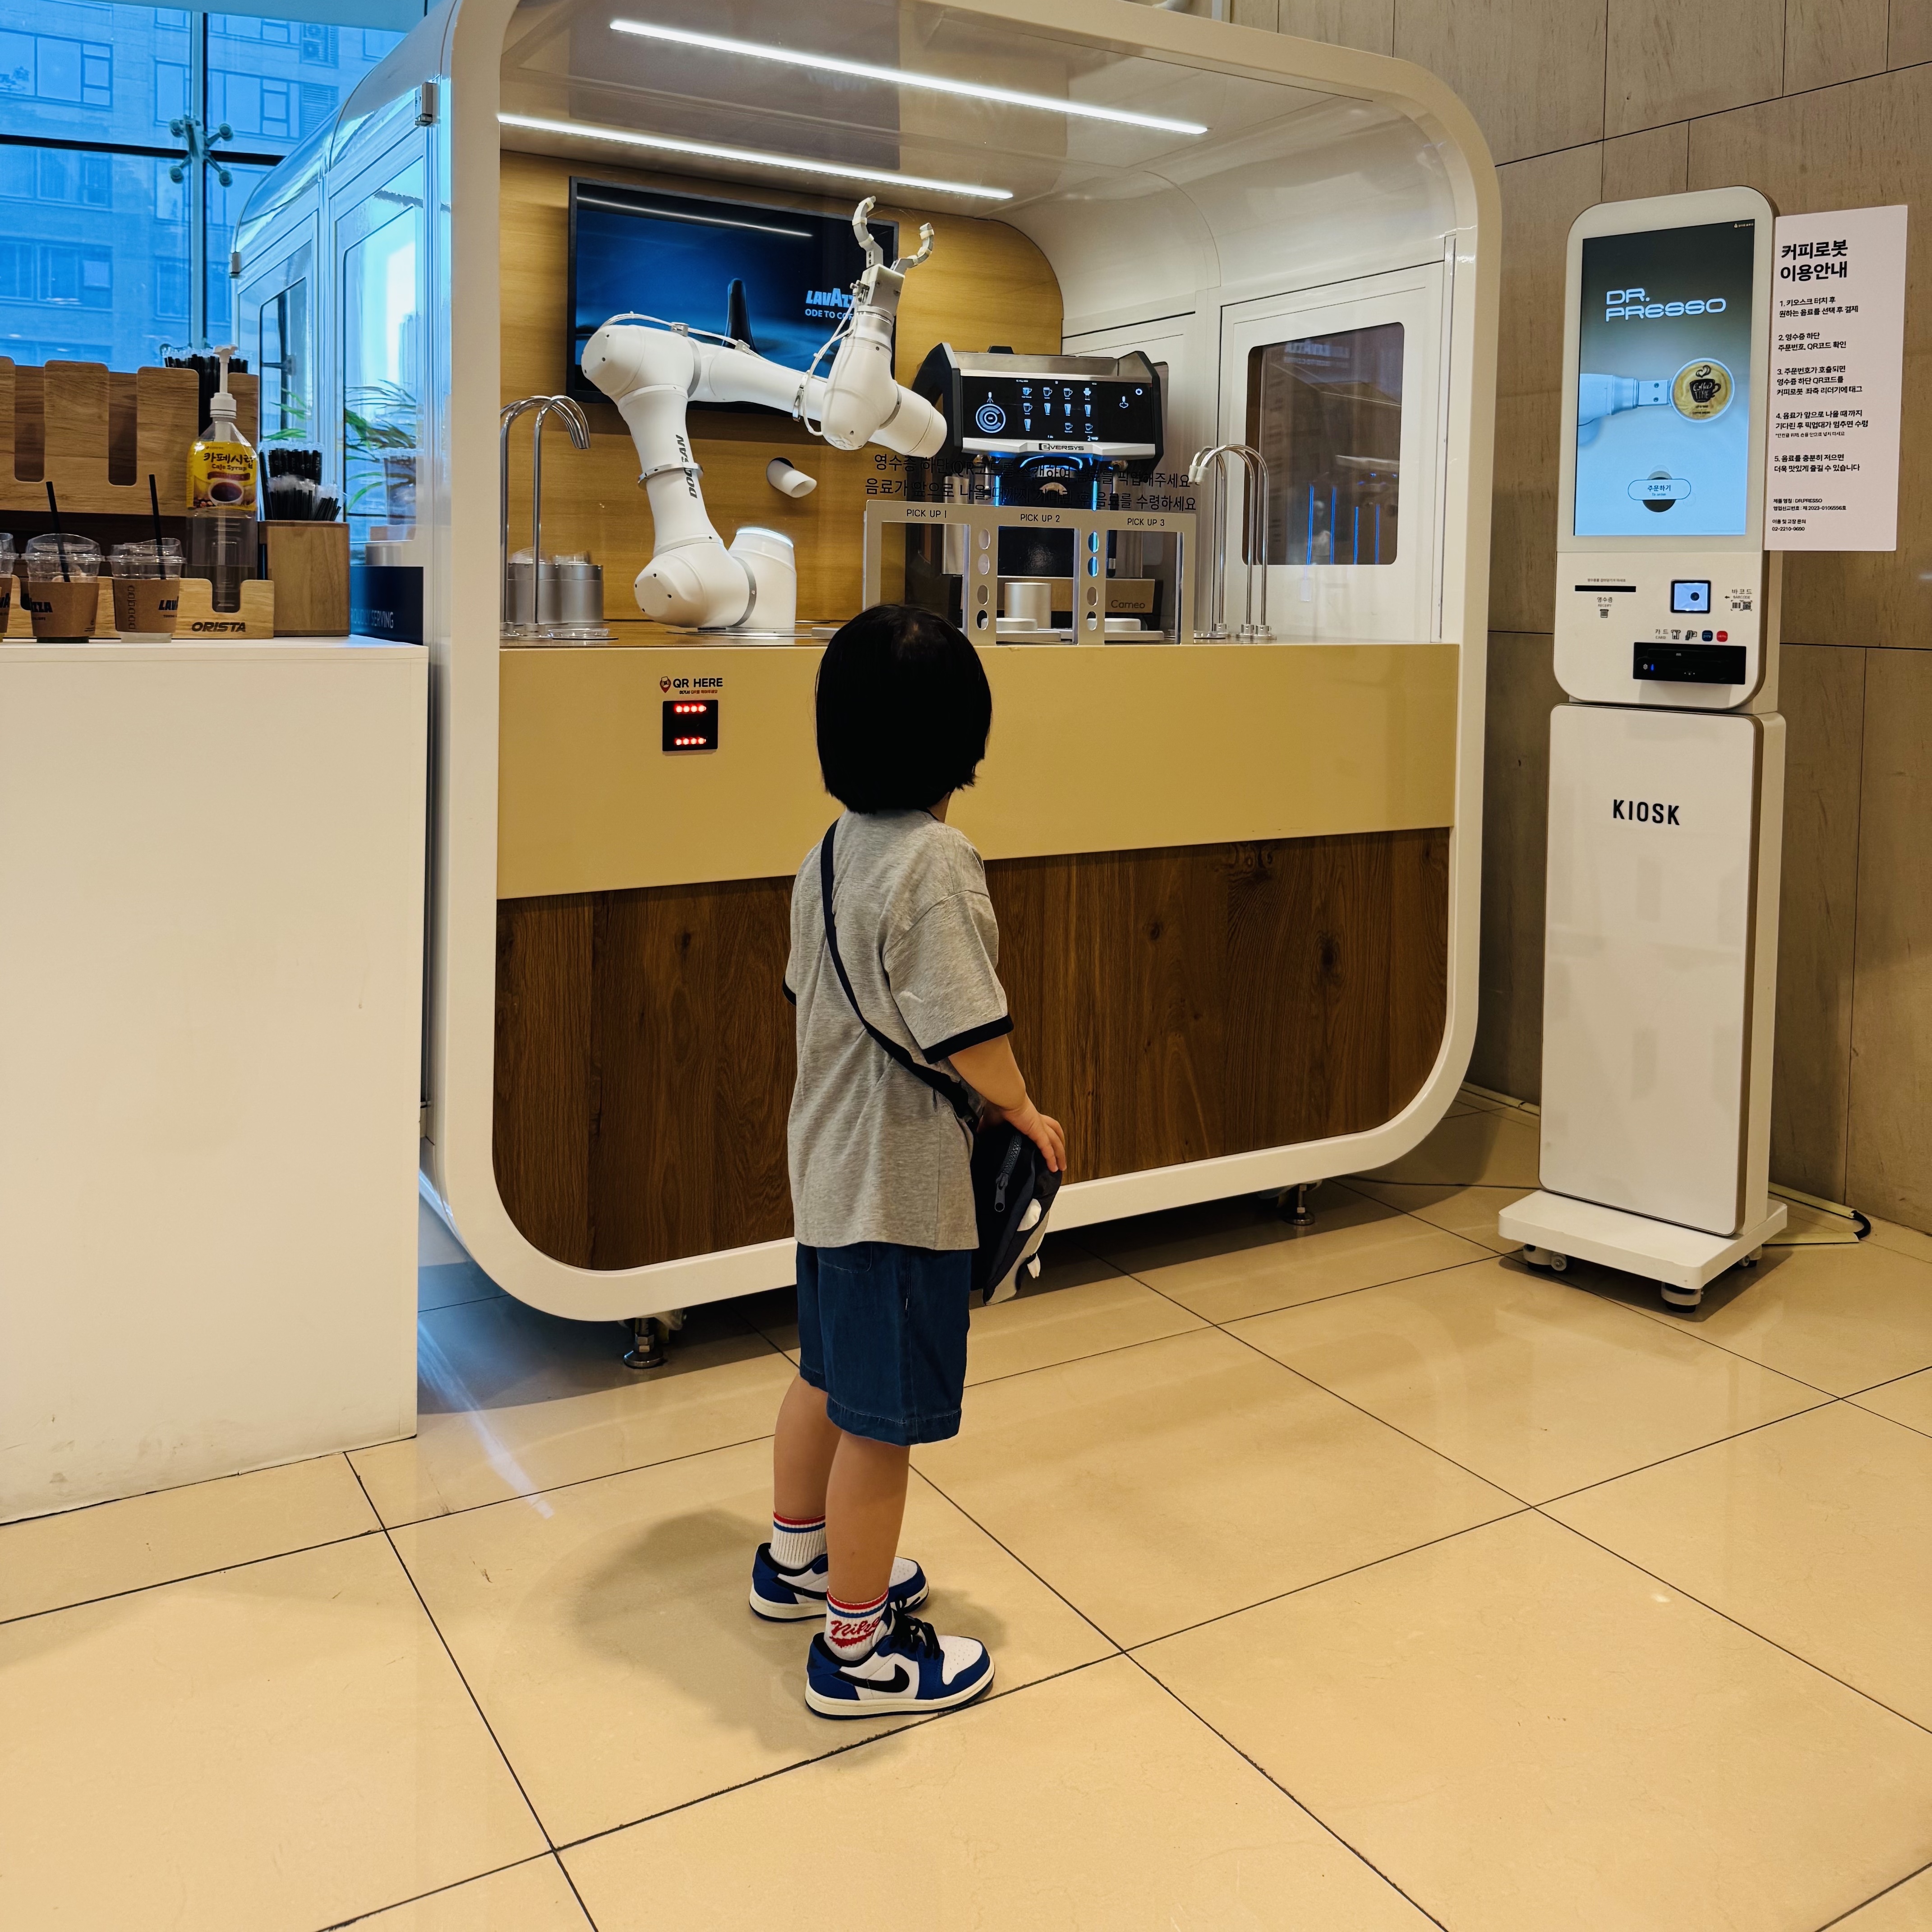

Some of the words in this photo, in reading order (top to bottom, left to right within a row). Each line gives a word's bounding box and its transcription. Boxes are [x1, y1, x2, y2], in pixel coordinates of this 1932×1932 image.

[1781, 239, 1848, 260] 커피로봇
[1780, 261, 1847, 281] 이용안내
[806, 288, 854, 308] LAVAZ
[1606, 288, 1650, 305] DR.
[1786, 298, 1813, 306] 키오스크
[805, 308, 822, 317] ODE
[824, 310, 835, 318] TO
[1780, 309, 1799, 317] 원하는
[1800, 308, 1820, 316] 음료를
[1785, 333, 1805, 341] 영수증
[1807, 342, 1831, 350] QR코드
[1784, 367, 1817, 375] 주문번호가
[1813, 376, 1844, 384] QR코드를
[203, 452, 254, 469] 카페시럽
[875, 454, 916, 472] 영수증
[922, 456, 947, 474] 하단
[952, 460, 1014, 478] QR코드를
[1019, 465, 1070, 482] 스캔하여
[1118, 470, 1190, 488] 픽업해주세요
[865, 478, 907, 497] 음료가
[913, 481, 954, 498] 앞으로
[960, 484, 986, 501] 나올
[1035, 487, 1073, 506] 기다린
[1097, 492, 1132, 509] 음료를
[1136, 494, 1196, 511] 수령하세요
[907, 509, 926, 517] PICK
[1111, 600, 1145, 609] Cameo
[192, 622, 246, 632] ORISTA
[673, 678, 689, 688] QR
[694, 678, 723, 687] HERE
[1613, 799, 1680, 825] KIOSK
